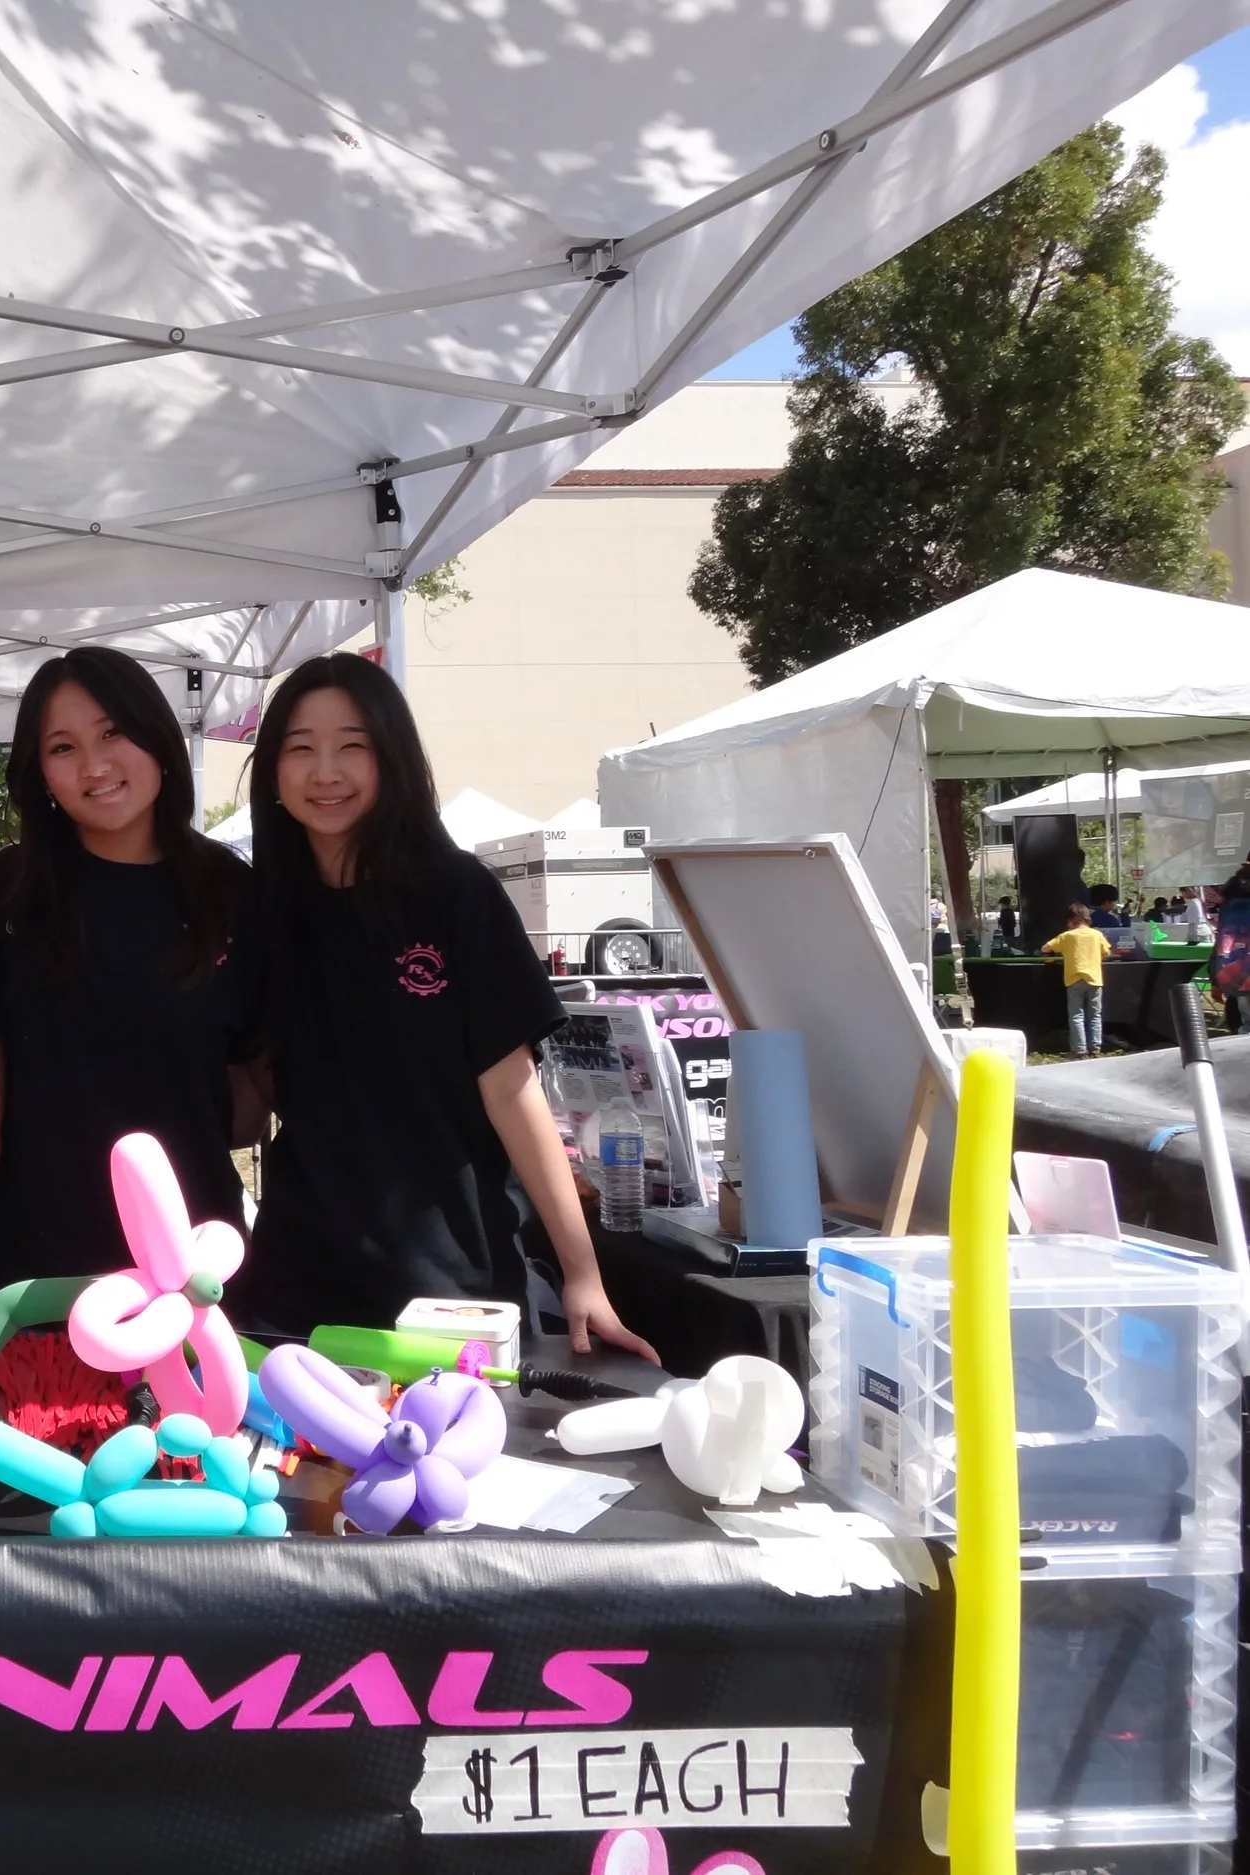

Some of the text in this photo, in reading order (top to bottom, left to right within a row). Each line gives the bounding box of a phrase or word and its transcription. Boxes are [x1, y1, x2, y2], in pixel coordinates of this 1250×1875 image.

[594, 994, 720, 1011] ANK YO
[463, 1740, 789, 1824] $1 EACH
